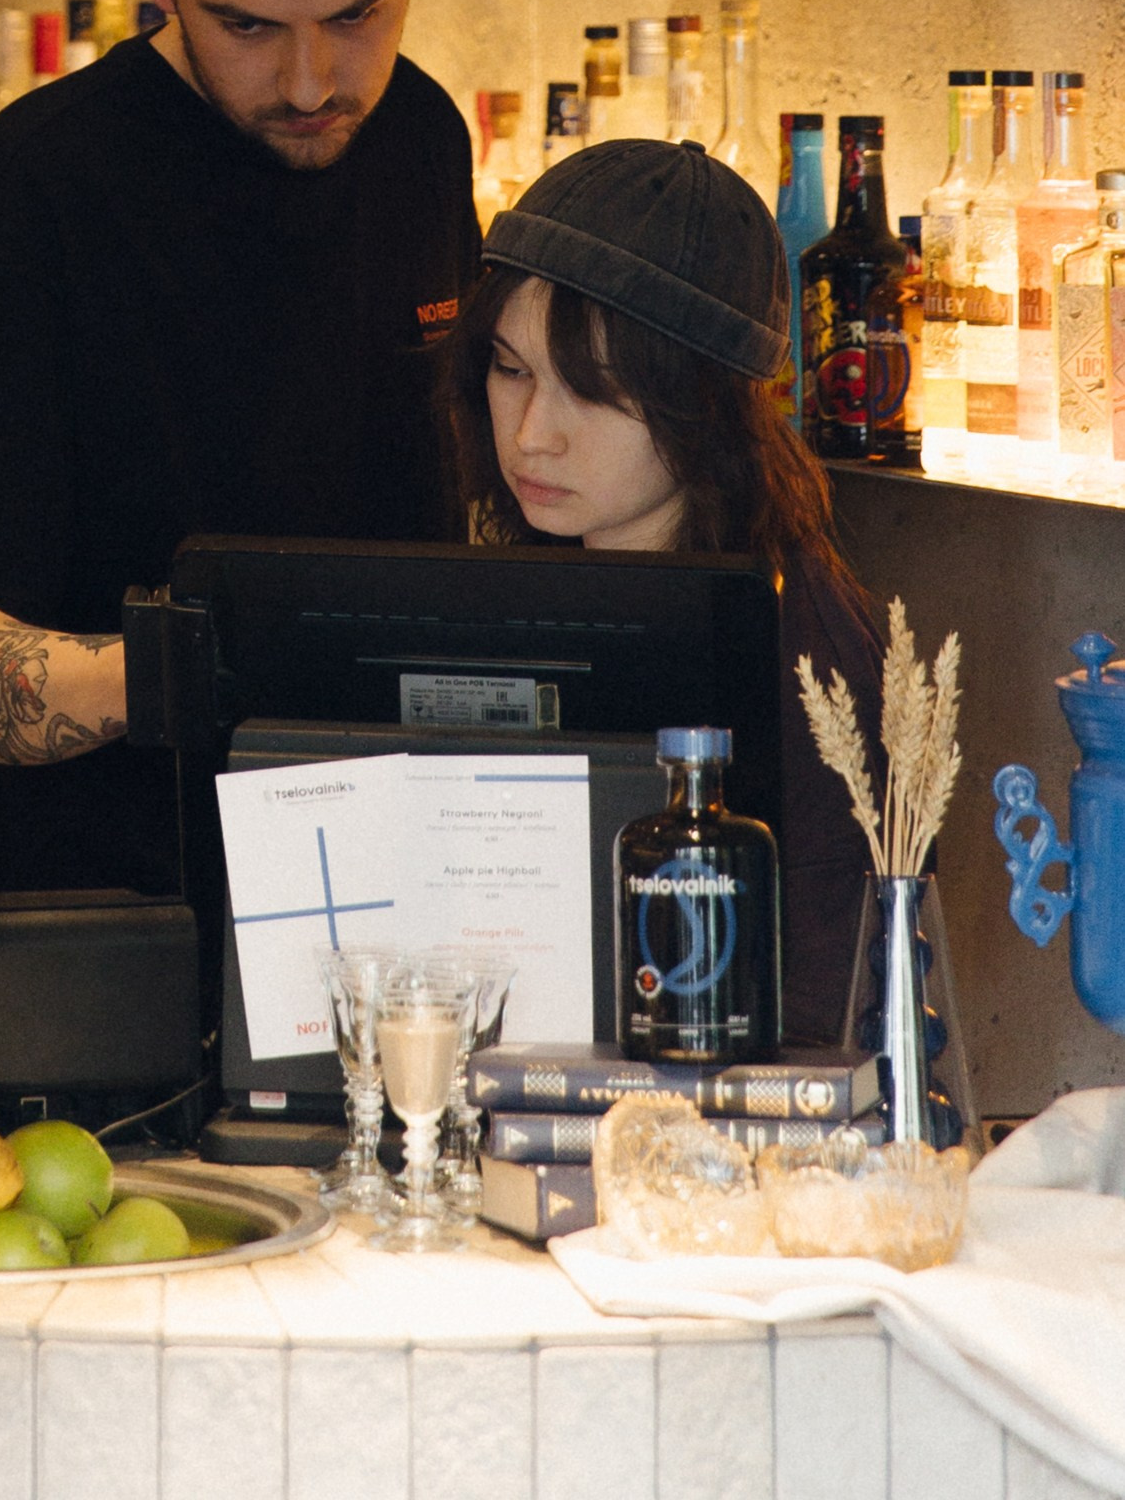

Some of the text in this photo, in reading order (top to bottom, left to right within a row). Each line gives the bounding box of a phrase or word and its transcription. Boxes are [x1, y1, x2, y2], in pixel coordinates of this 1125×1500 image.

[439, 808, 543, 820] Strawberry Negroni
[443, 865, 542, 876] Apple pie Highball
[461, 927, 502, 939] Orange
